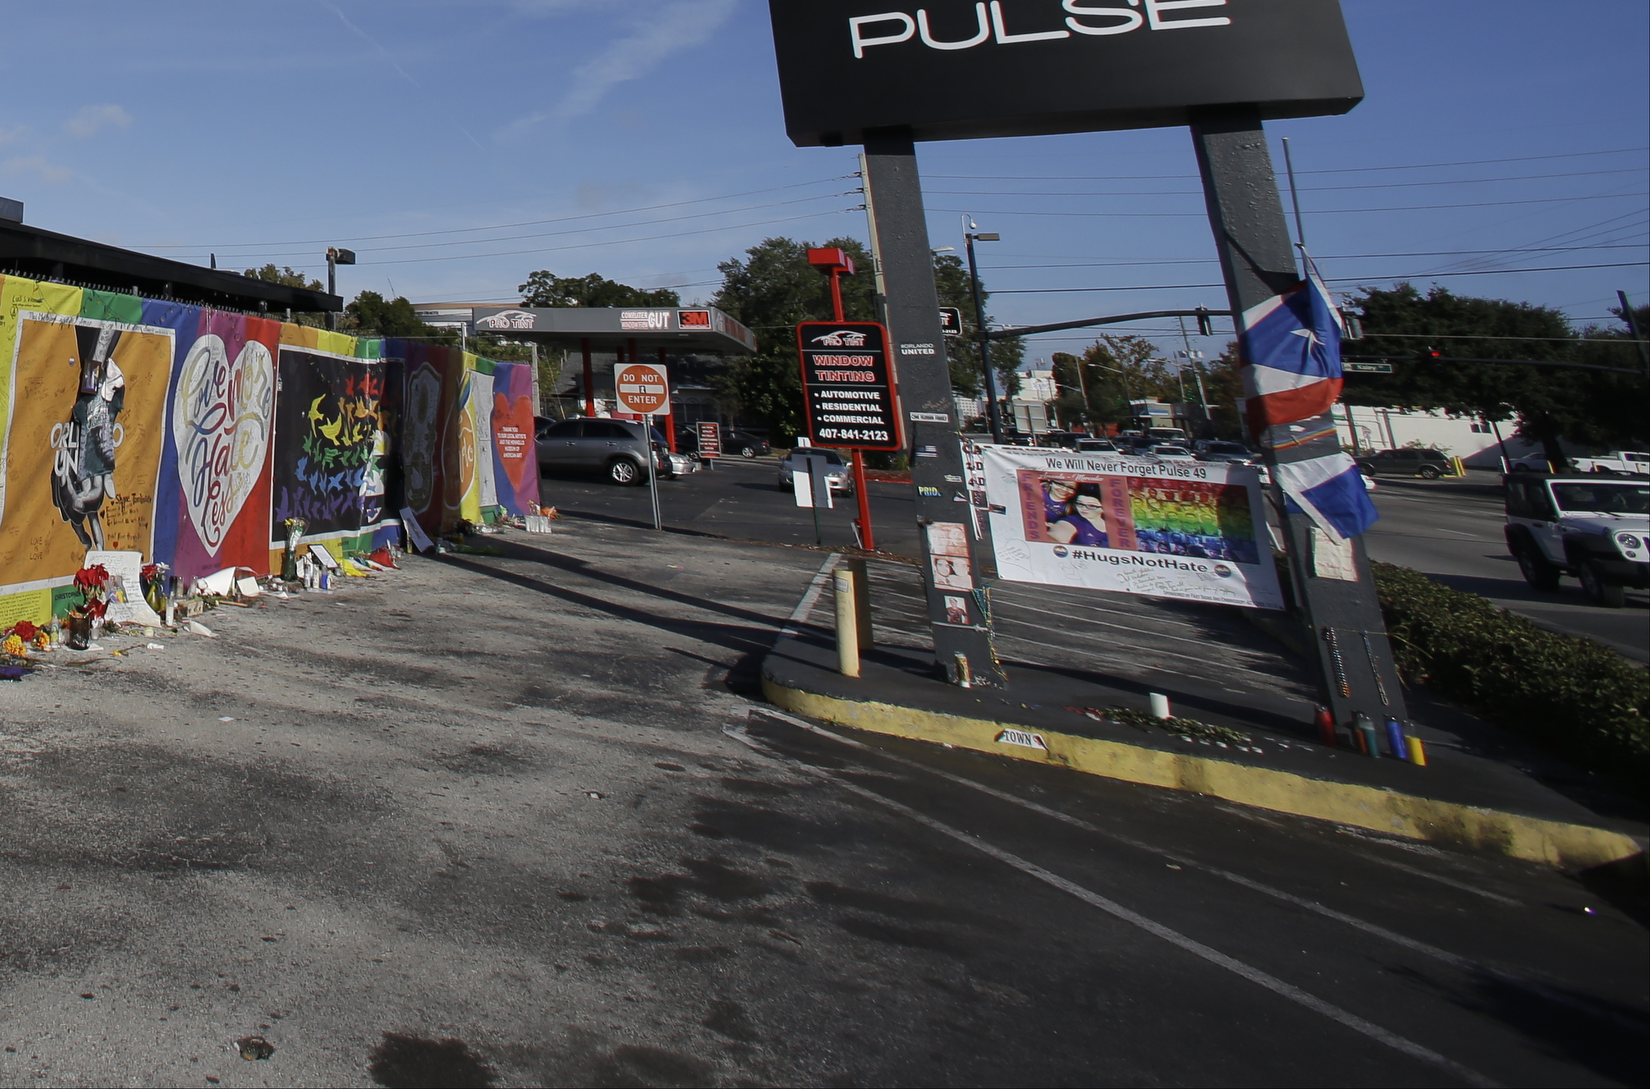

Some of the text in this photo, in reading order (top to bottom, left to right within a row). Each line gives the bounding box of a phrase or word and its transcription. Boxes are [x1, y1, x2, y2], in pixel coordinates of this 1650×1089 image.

[511, 318, 535, 329] TINT
[648, 311, 670, 329] CUT
[682, 312, 709, 325] 3M
[843, 337, 865, 346] TINT
[812, 354, 875, 366] WINDOW
[623, 374, 659, 383] DO NOT
[815, 370, 875, 382] TINTING
[628, 395, 658, 404] ENTER
[821, 390, 881, 400] AUTOMOTIVE
[822, 402, 883, 412] RESIDENTIAL
[823, 414, 885, 424] COMMERCIAL
[819, 428, 889, 441] 407-841-2123
[1046, 458, 1207, 479] We Will Never Forget Pulse 49
[1110, 478, 1131, 548] FOREVER
[1072, 549, 1208, 573] #HugsNotHate
